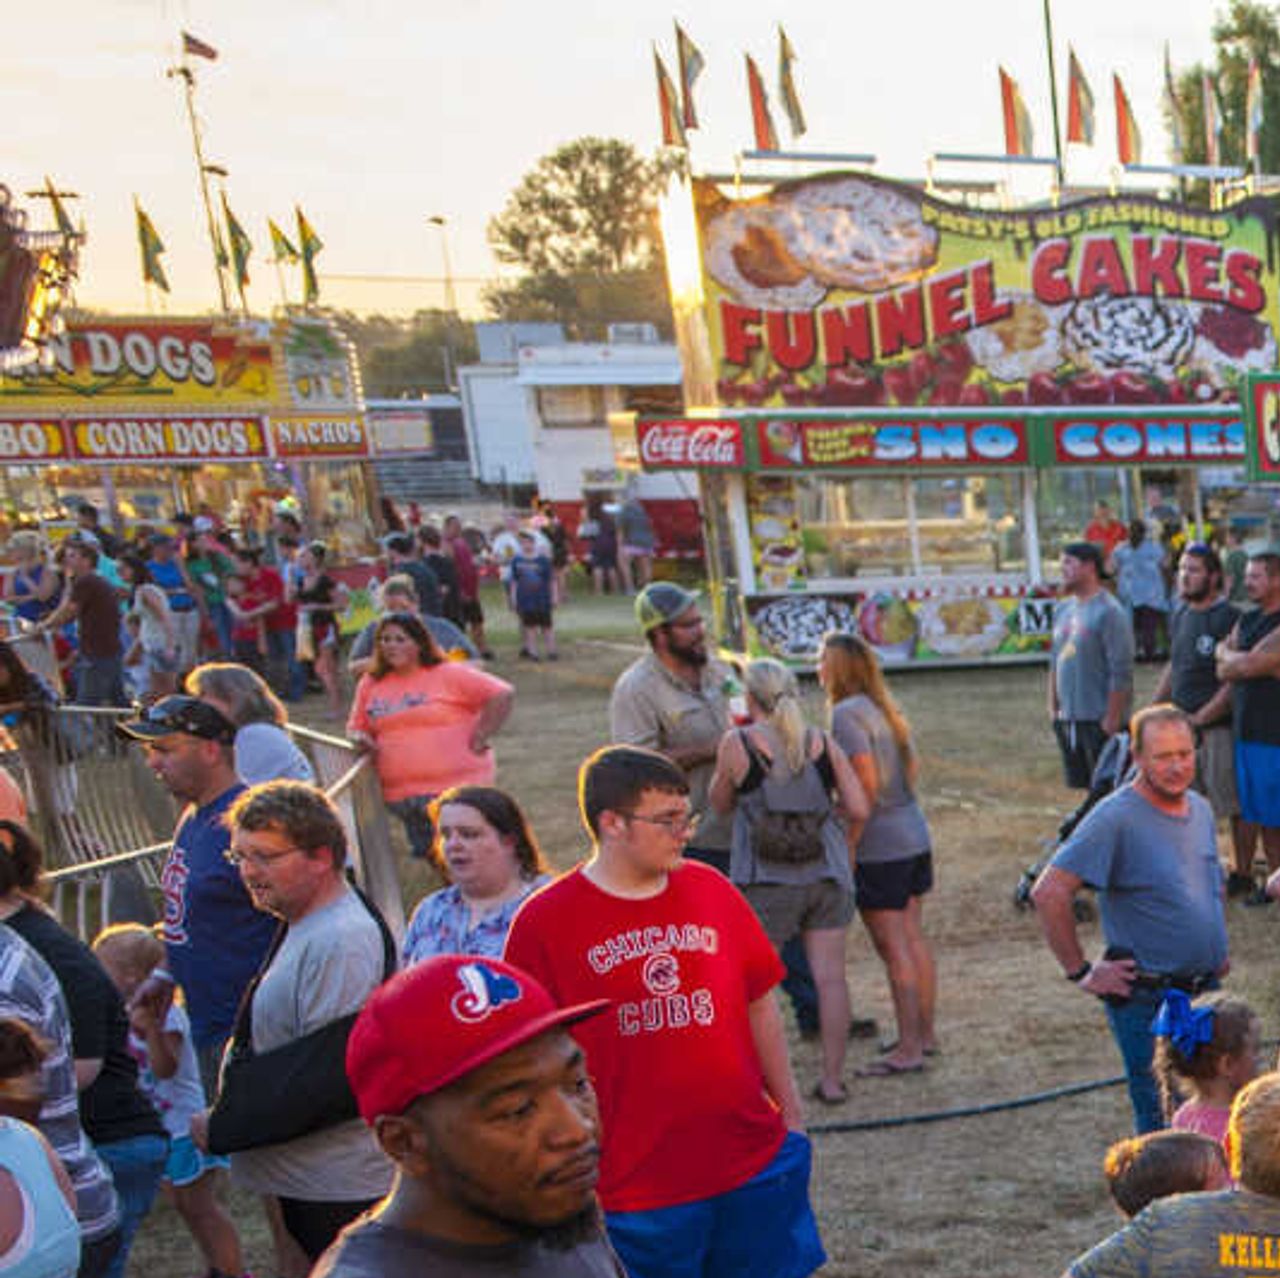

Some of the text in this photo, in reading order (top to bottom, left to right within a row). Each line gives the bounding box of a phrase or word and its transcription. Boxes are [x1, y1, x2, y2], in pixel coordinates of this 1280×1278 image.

[718, 233, 1268, 371] FUNNEL CAKES
[87, 332, 218, 388] DOGS
[86, 420, 250, 456] CORN DOGS
[277, 421, 362, 446] NACHOS
[641, 423, 736, 464] Coca-Cola
[873, 423, 1019, 460] SNO
[1060, 421, 1246, 458] CONES
[587, 922, 719, 975] CHICAGO
[618, 987, 715, 1036] CUBS
